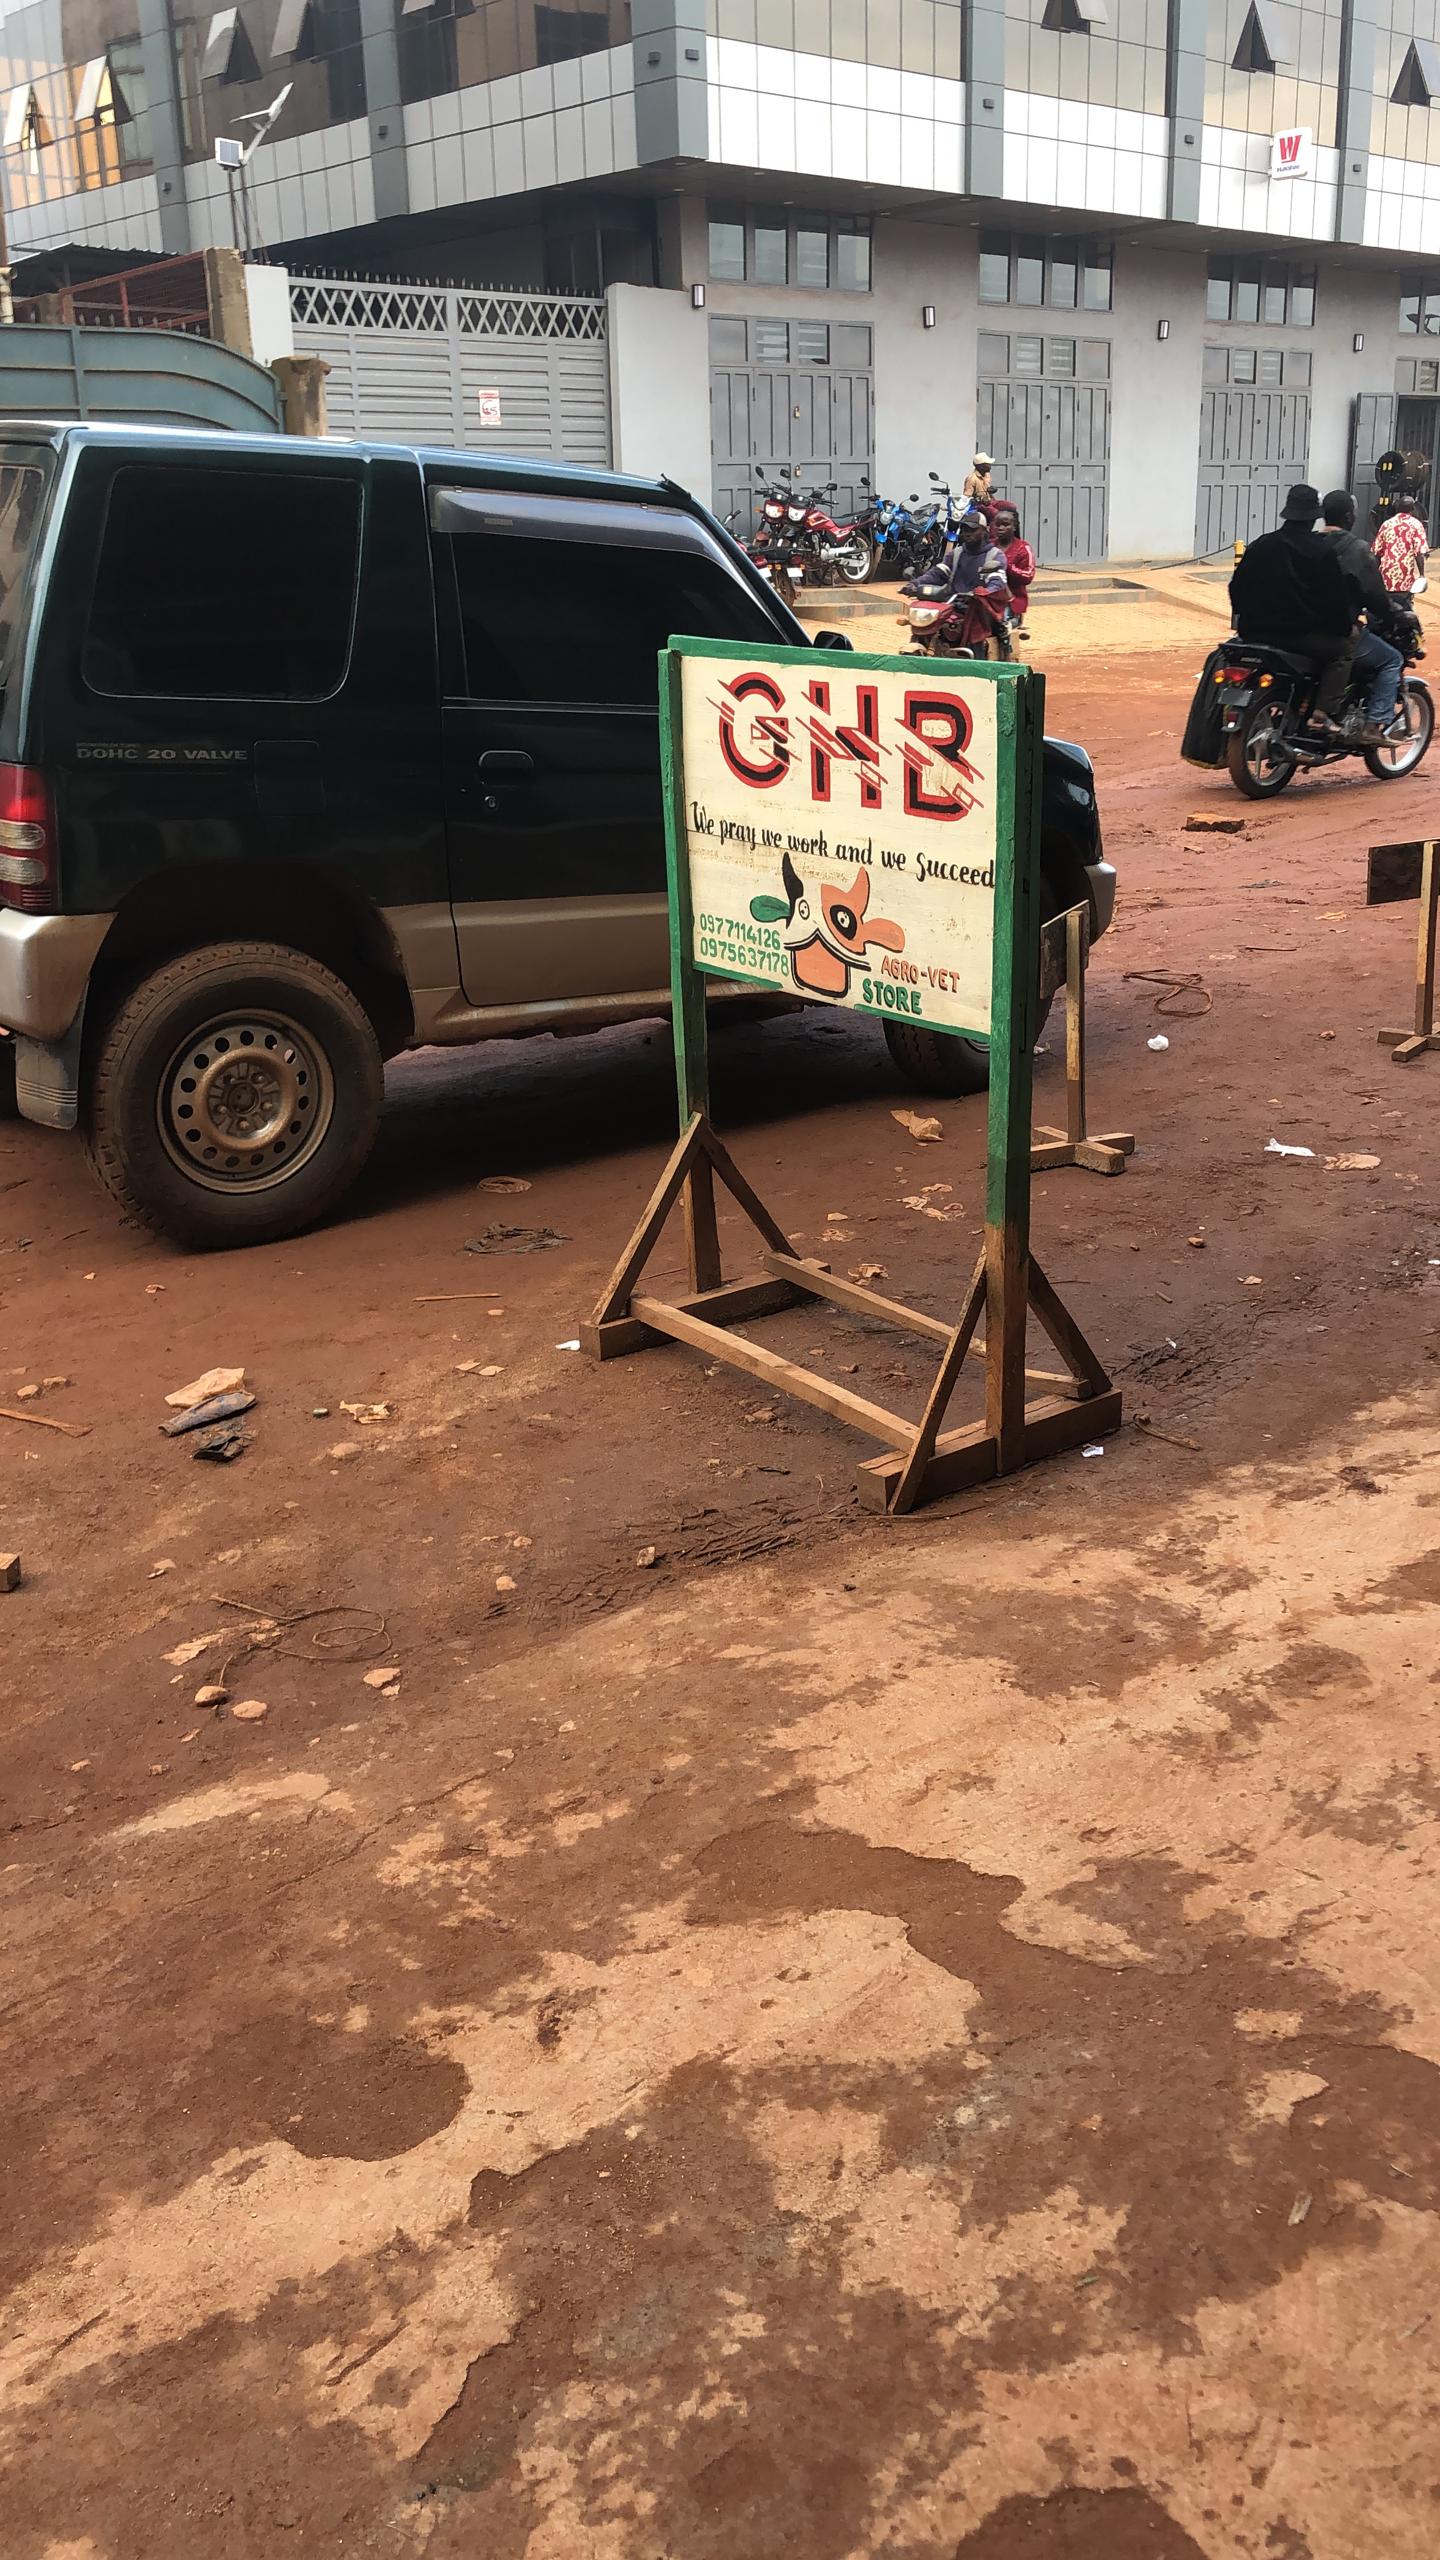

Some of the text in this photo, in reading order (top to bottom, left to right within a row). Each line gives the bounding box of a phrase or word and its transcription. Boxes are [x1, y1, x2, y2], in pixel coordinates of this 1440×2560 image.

[77, 748, 249, 761] DOHC 20 VALVE
[706, 671, 984, 822] GHB
[690, 800, 996, 889] We pray we work and we Succeed
[700, 913, 781, 951] 0977114126
[700, 936, 790, 977] 0975637178
[881, 955, 960, 993] AGRO-VET
[862, 977, 923, 1015] STORE
